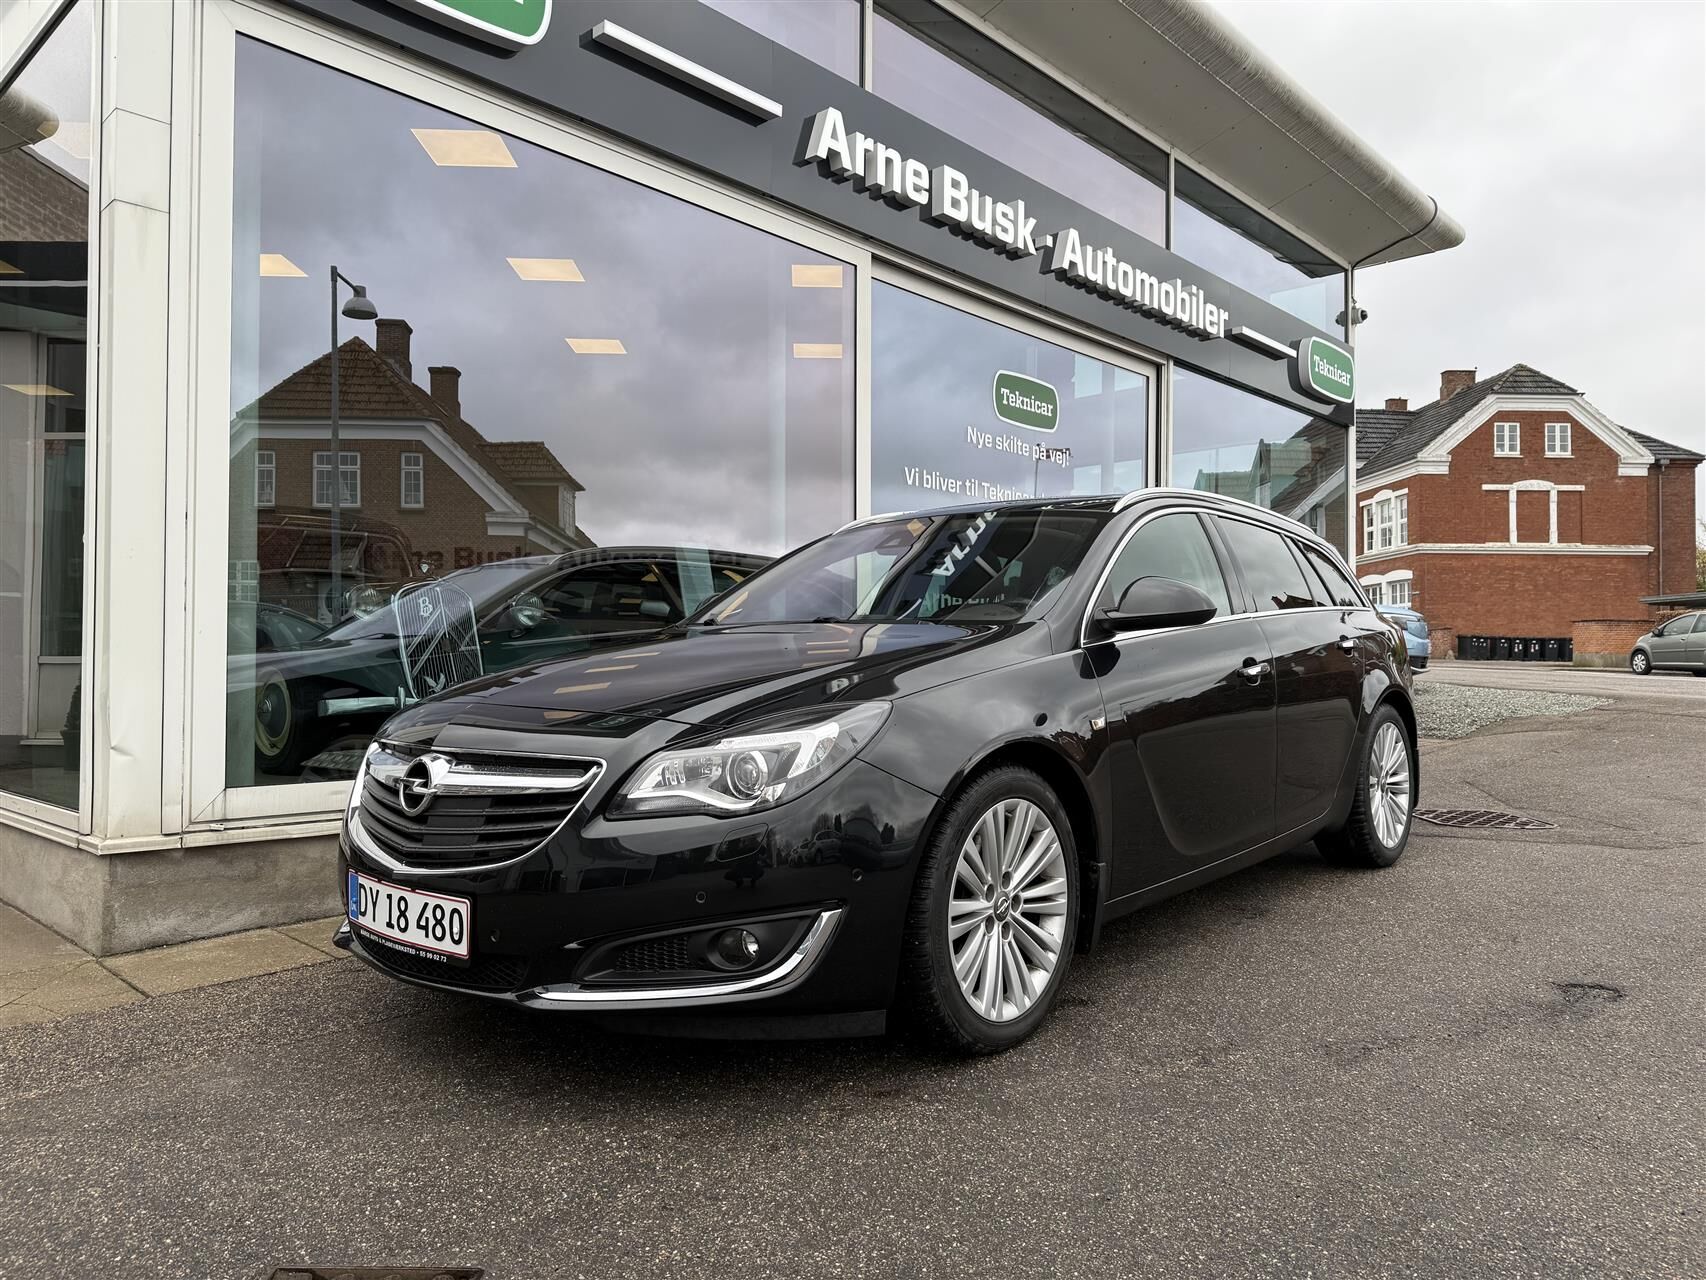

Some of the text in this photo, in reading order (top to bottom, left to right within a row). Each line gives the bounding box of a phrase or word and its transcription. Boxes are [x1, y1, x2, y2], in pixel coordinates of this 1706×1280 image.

[805, 106, 930, 205] Arne
[936, 164, 1037, 256] Busk
[1060, 227, 1229, 338] Automobiler
[1313, 354, 1351, 387] Teknicar
[1001, 388, 1053, 417] Teknicar
[967, 425, 1070, 468] Nye skilte på vej!
[904, 466, 919, 486] Vi
[923, 470, 962, 493] bliver
[965, 479, 979, 497] til
[358, 882, 380, 923] DY
[386, 893, 410, 934] 18
[416, 901, 464, 945] 480
